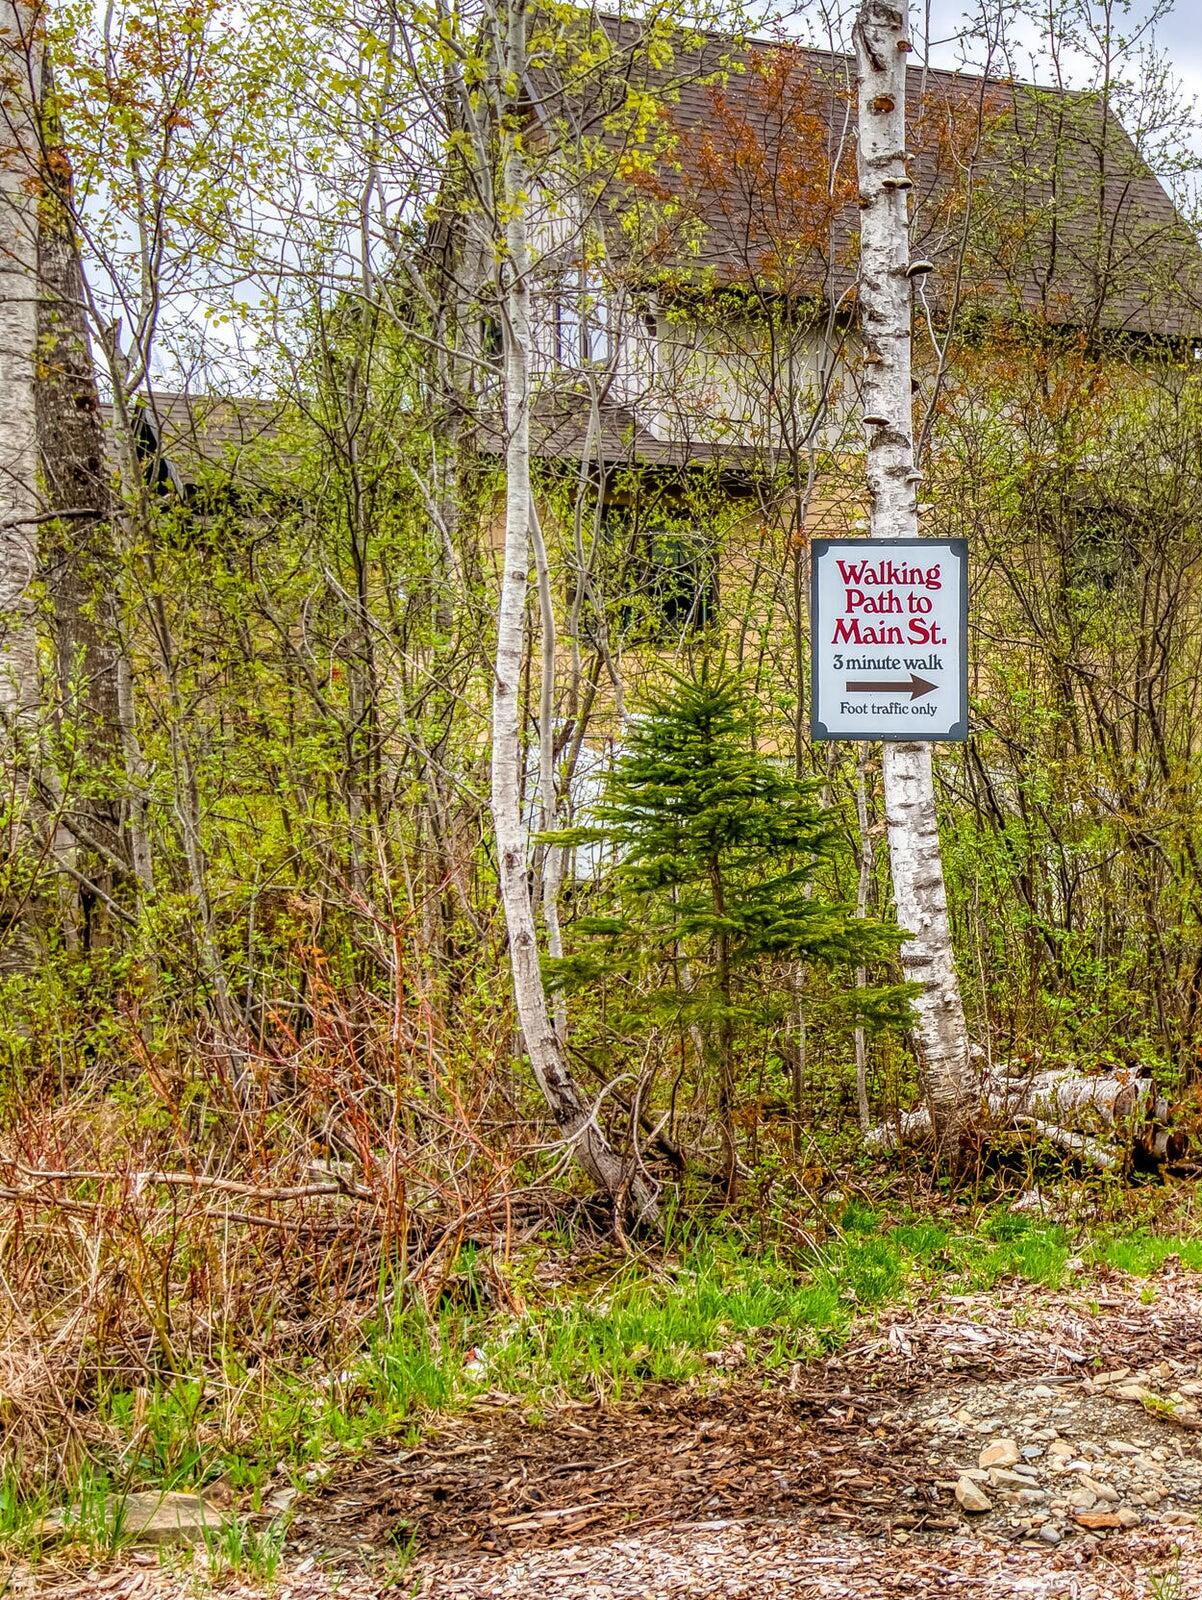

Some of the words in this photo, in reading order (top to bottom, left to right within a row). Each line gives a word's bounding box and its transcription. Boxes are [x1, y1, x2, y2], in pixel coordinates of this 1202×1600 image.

[836, 560, 942, 590] Walking
[845, 588, 903, 613] Path
[907, 591, 933, 613] to
[831, 618, 905, 645] Main
[907, 617, 947, 645] St.
[833, 654, 843, 670] 3
[845, 655, 901, 670] minute
[904, 654, 943, 670] walk
[840, 702, 869, 715] Foot
[871, 702, 909, 715] traffic
[911, 702, 937, 717] only
